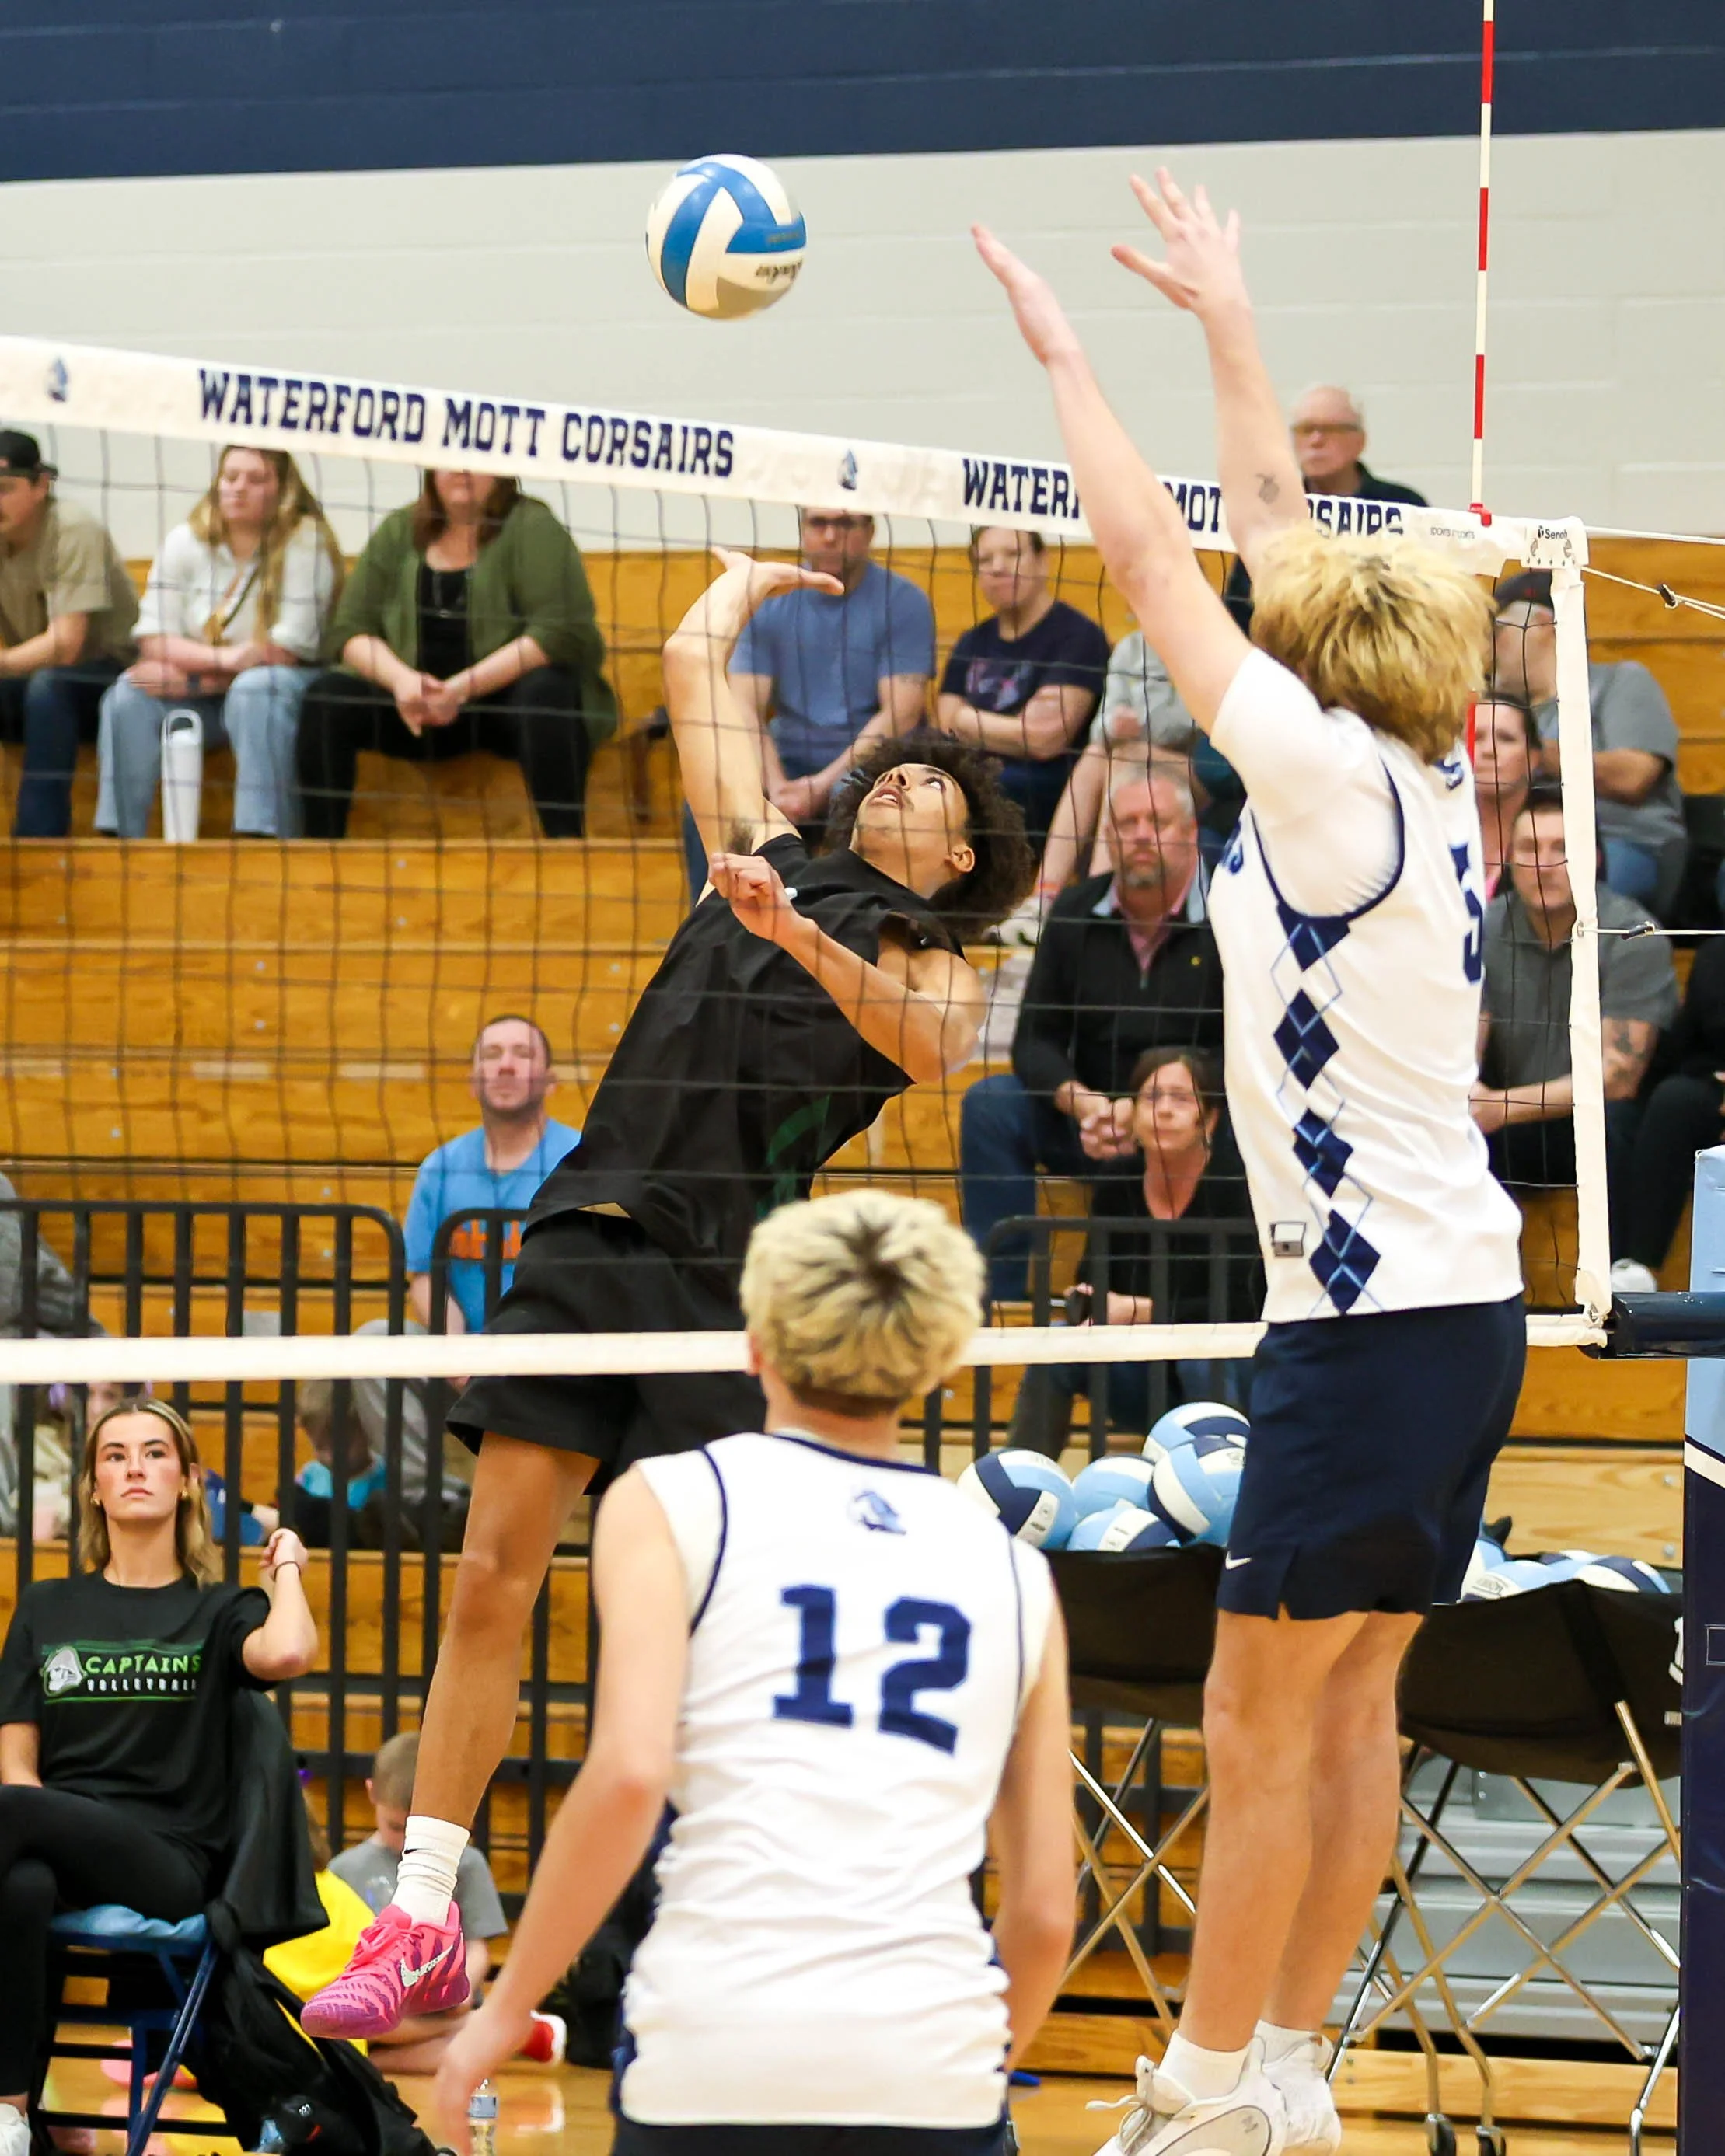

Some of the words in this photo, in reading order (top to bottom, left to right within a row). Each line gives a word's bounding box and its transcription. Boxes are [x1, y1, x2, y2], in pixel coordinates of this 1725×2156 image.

[199, 368, 426, 443] WATERFORD
[442, 398, 546, 458] MOTT
[562, 412, 735, 478] CORSAIRS
[962, 457, 1080, 520] WATER
[1163, 481, 1221, 533] MOT
[1307, 498, 1404, 538] SAIRS
[1545, 528, 1568, 539] Senoh
[85, 1654, 201, 1675] CAPTAINS
[773, 1583, 972, 1757] 12
